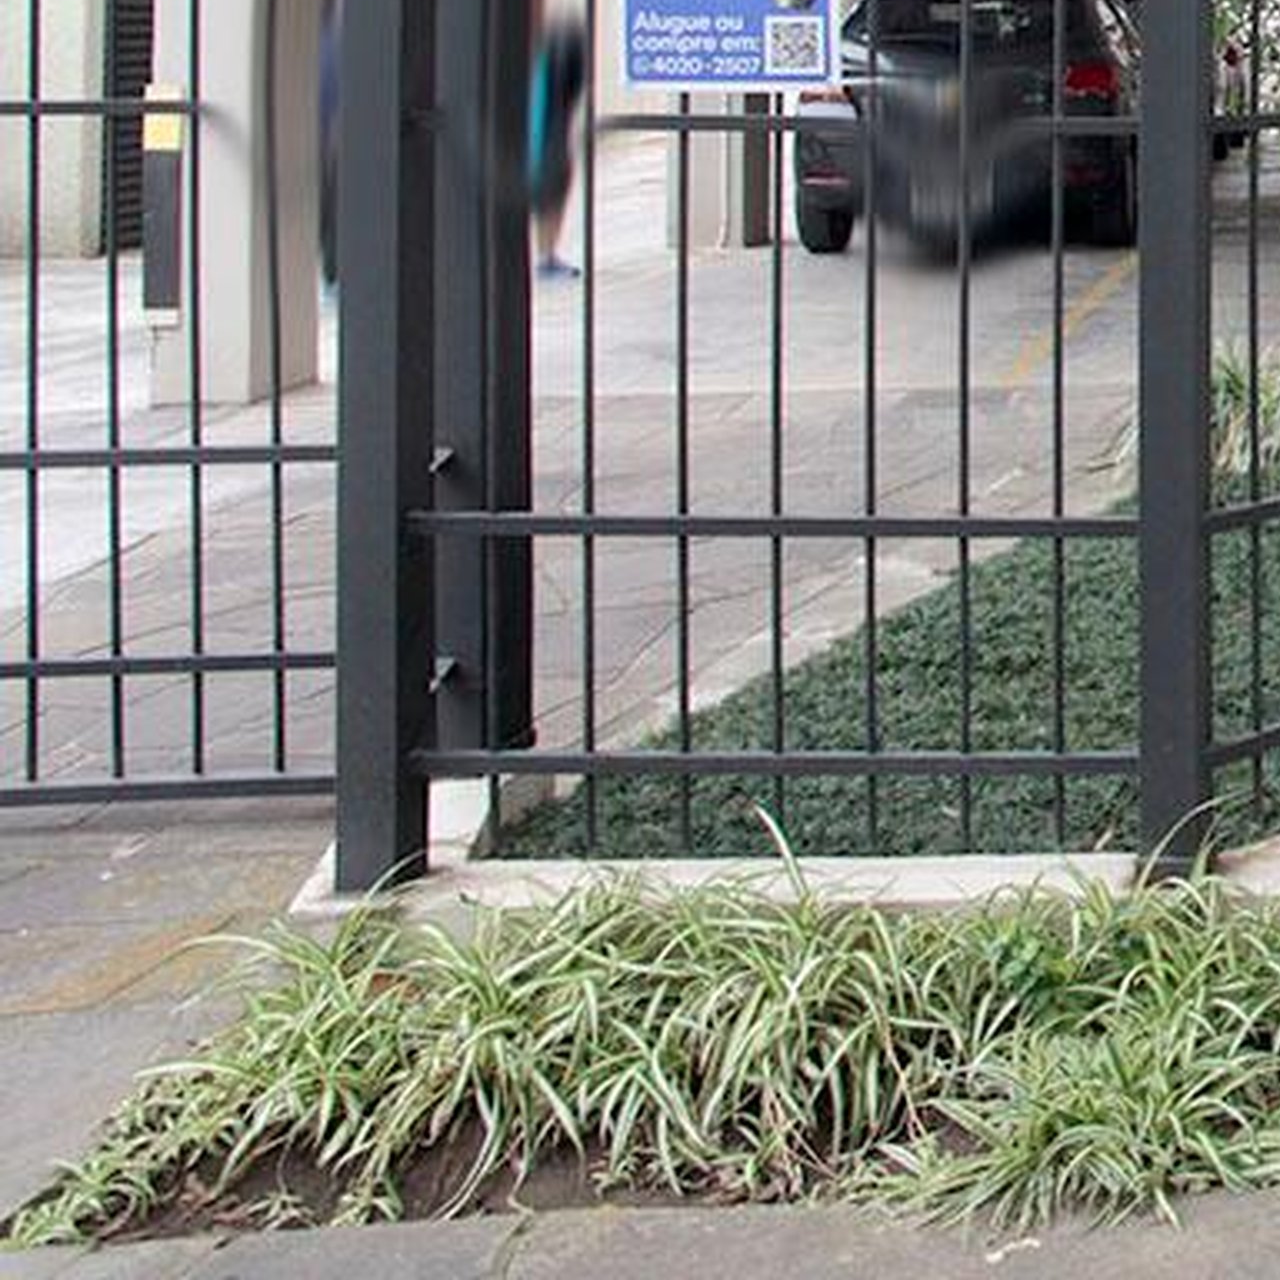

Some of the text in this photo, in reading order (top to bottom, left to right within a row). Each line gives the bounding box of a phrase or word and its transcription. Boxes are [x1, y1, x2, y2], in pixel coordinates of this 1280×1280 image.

[634, 12, 744, 34] Alugue ou
[631, 35, 717, 53] compre
